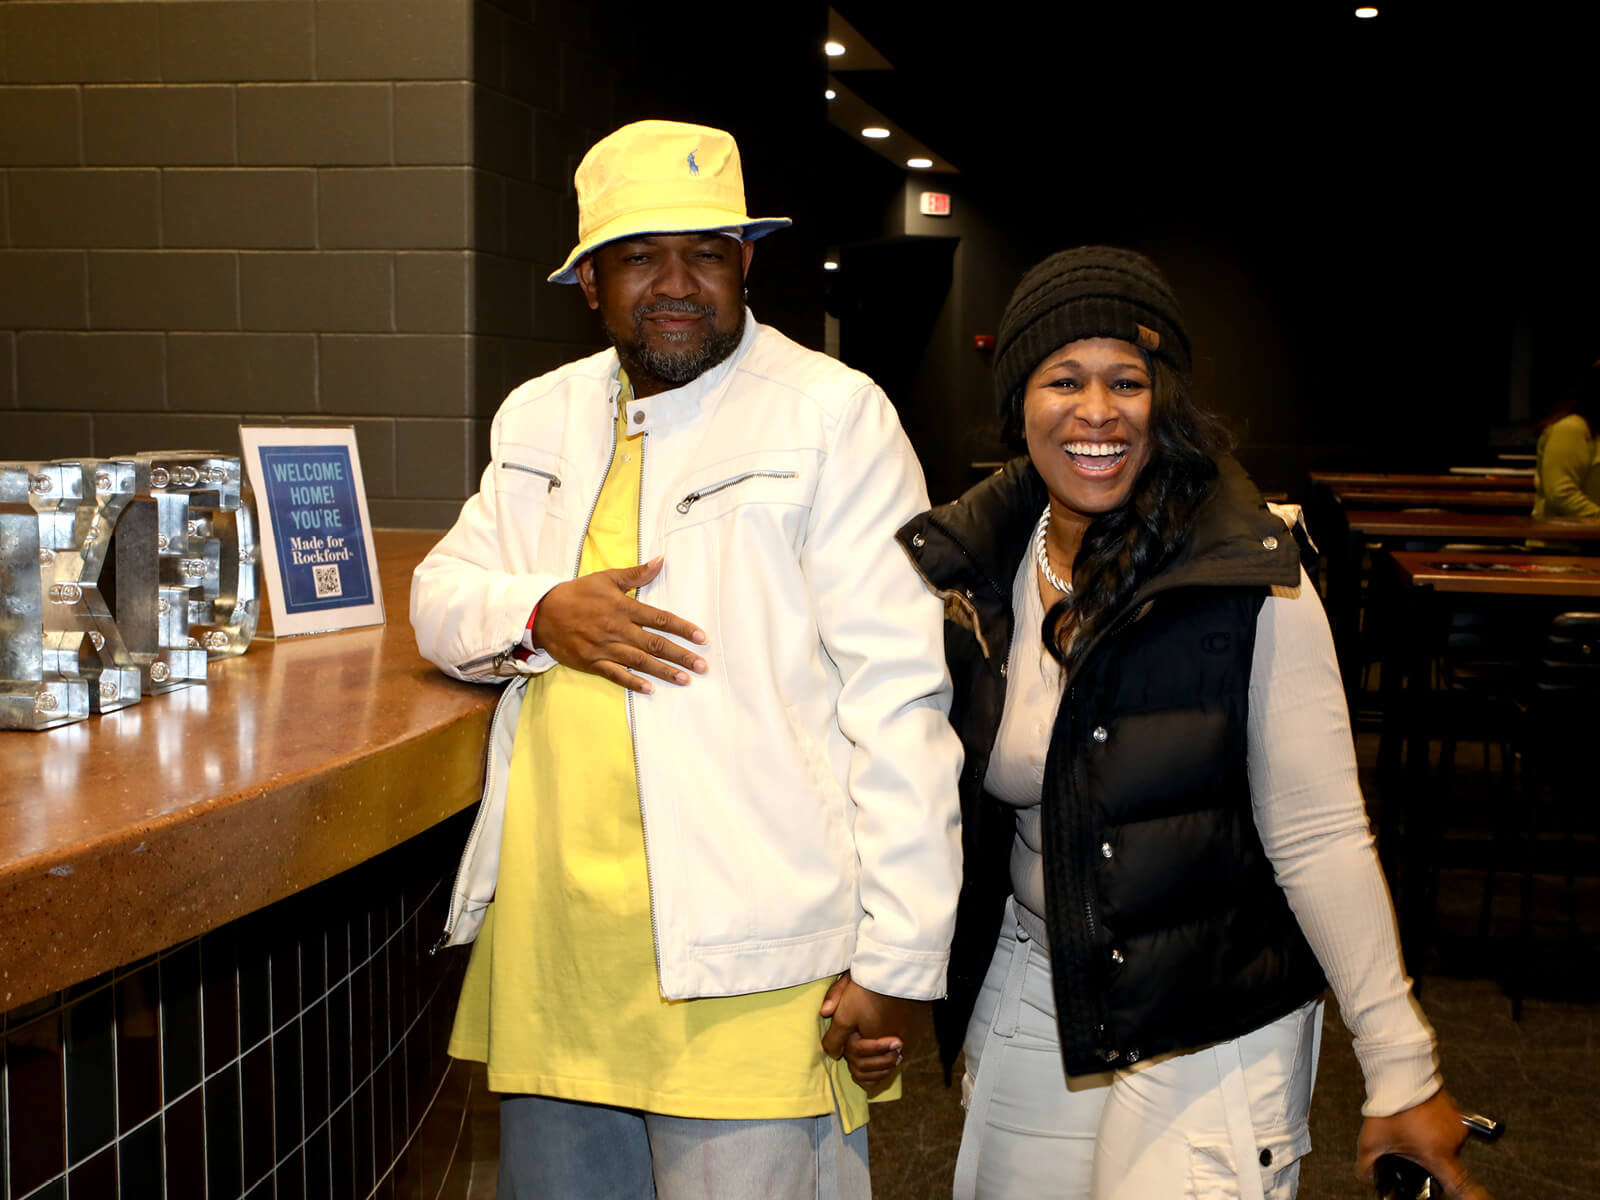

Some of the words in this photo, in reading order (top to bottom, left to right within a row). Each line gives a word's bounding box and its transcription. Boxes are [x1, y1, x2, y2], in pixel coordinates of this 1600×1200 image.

[272, 462, 344, 482] WELCOME
[290, 485, 335, 505] HOME!
[291, 508, 342, 530] YOU'RE
[290, 535, 324, 551] Made
[326, 535, 344, 548] for
[291, 547, 349, 565] Rockford
